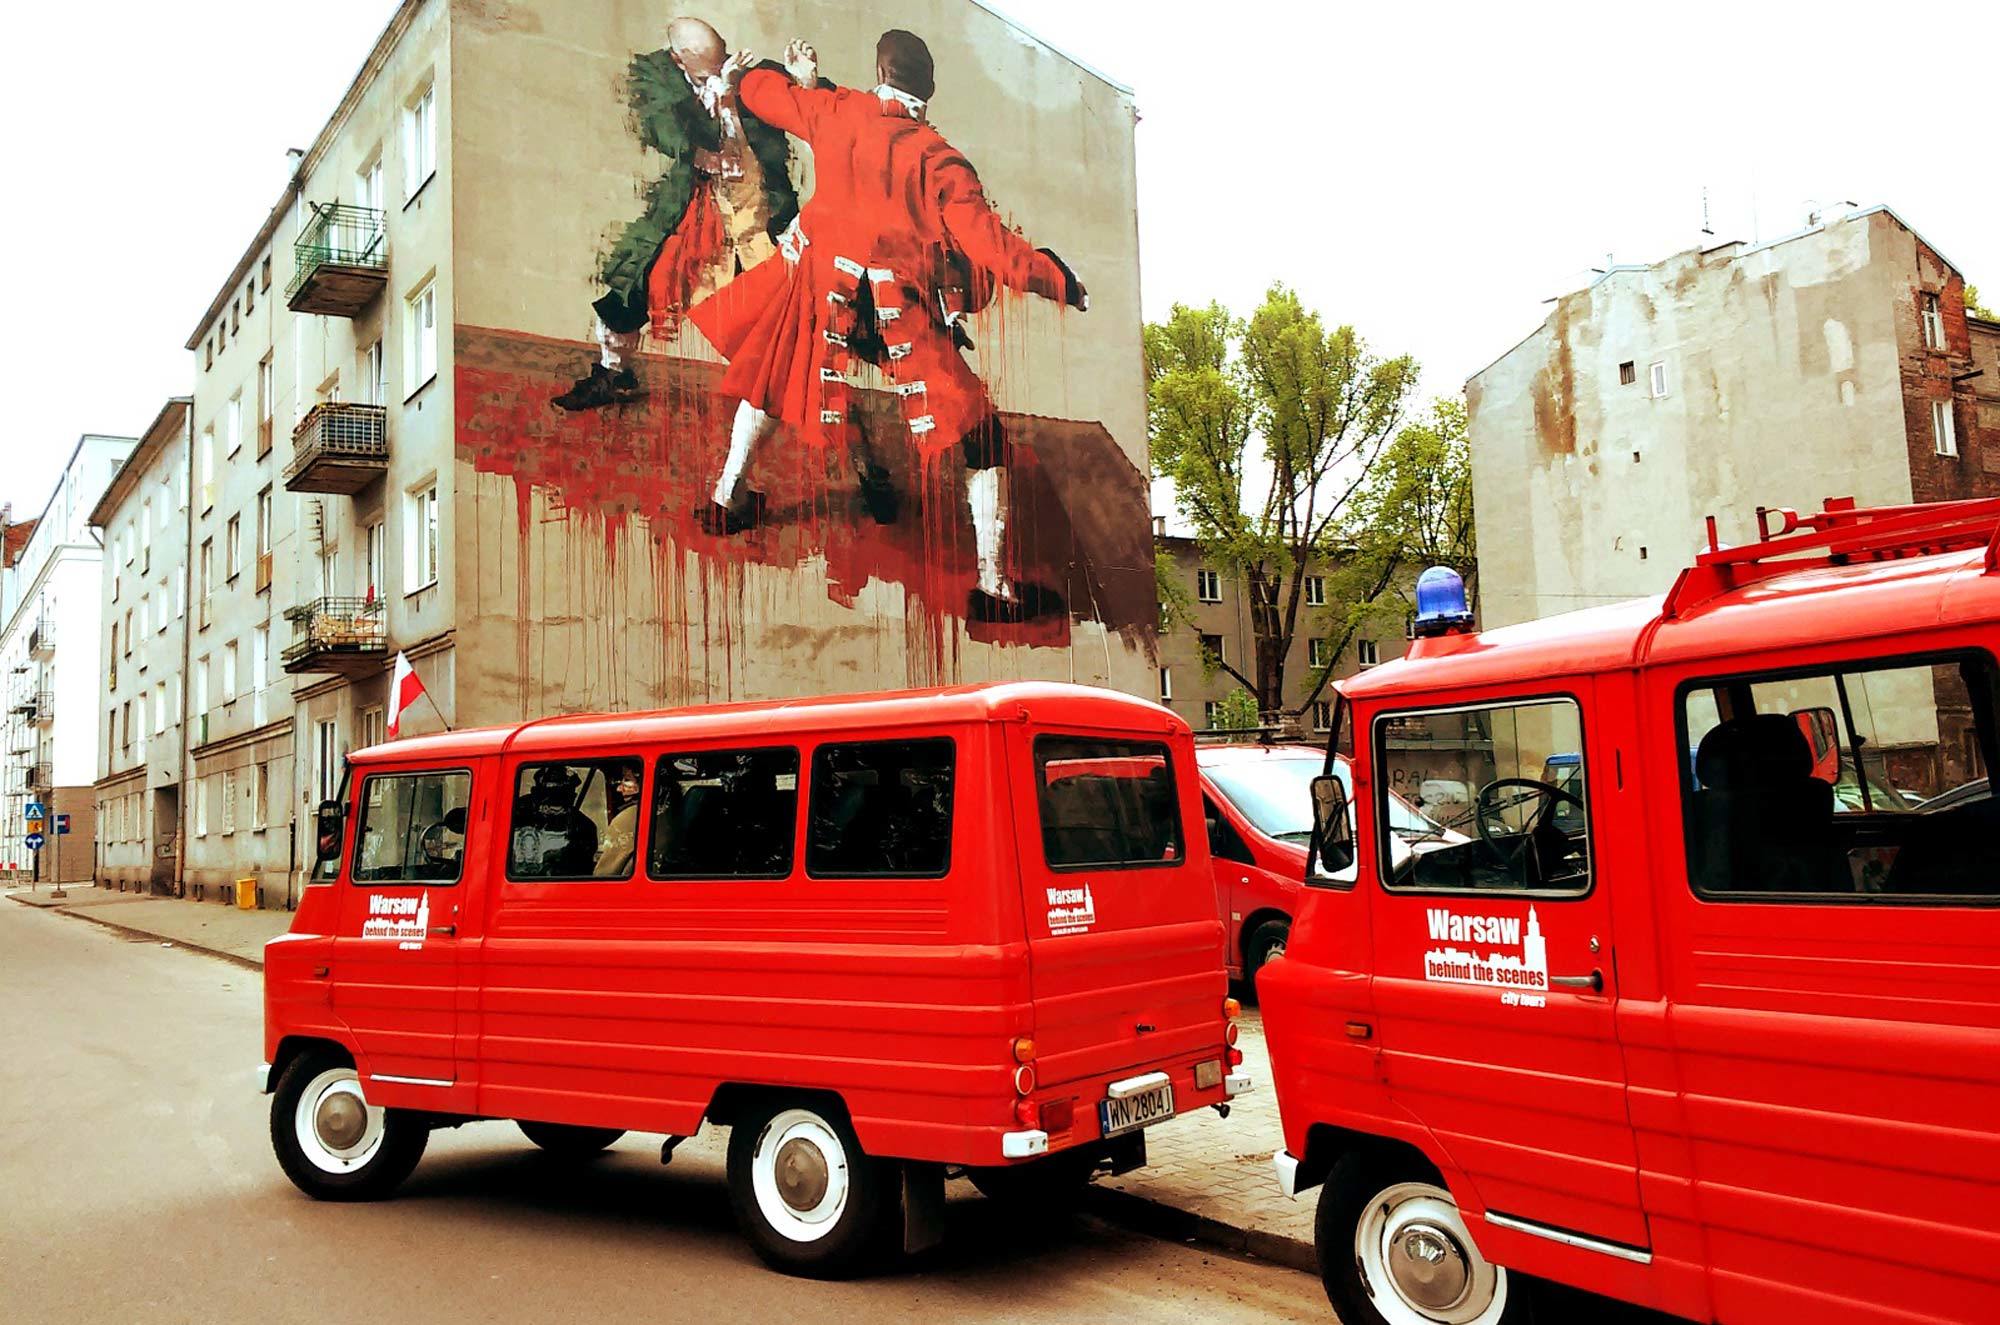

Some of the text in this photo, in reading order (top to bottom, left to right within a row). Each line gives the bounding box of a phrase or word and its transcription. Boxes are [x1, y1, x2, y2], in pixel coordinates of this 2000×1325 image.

[369, 894, 419, 915] Warsaw
[1046, 888, 1084, 906] Warsaw
[364, 925, 425, 938] behind the scenes
[1426, 908, 1520, 945] Warsaw
[1428, 959, 1545, 987] behind the scenes
[1501, 991, 1546, 1008] city tours
[1109, 1097, 1131, 1128] WN
